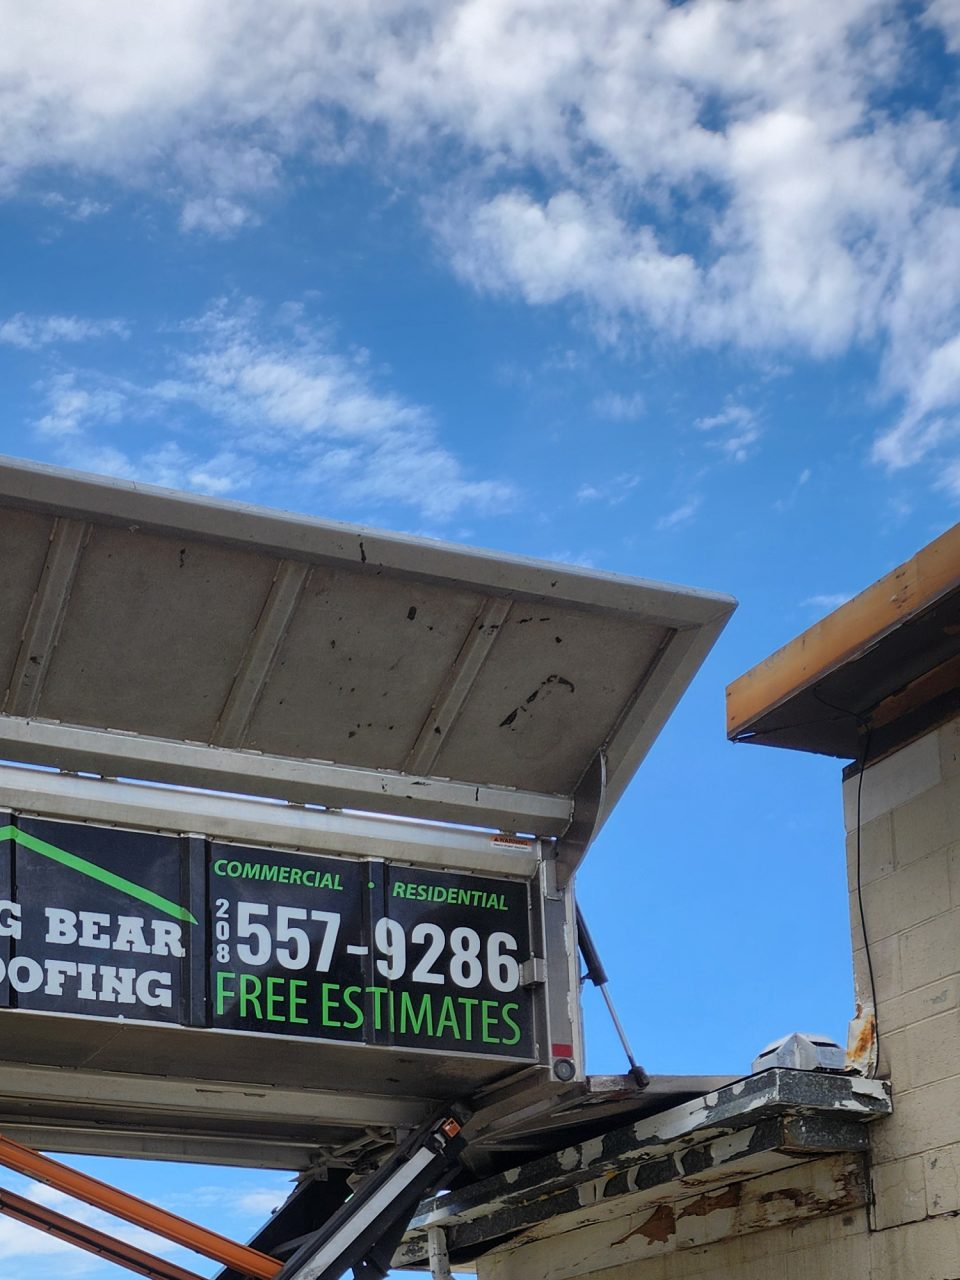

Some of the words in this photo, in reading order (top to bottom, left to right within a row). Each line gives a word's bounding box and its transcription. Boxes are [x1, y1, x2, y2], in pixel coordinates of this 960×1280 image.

[213, 858, 344, 891] COMMERCIAL
[392, 881, 509, 911] RESIDENTIAL
[44, 906, 186, 958] BEAR
[236, 901, 520, 993] 557-9286
[215, 971, 309, 1025] FREE
[322, 982, 521, 1046] ESTIMATES
